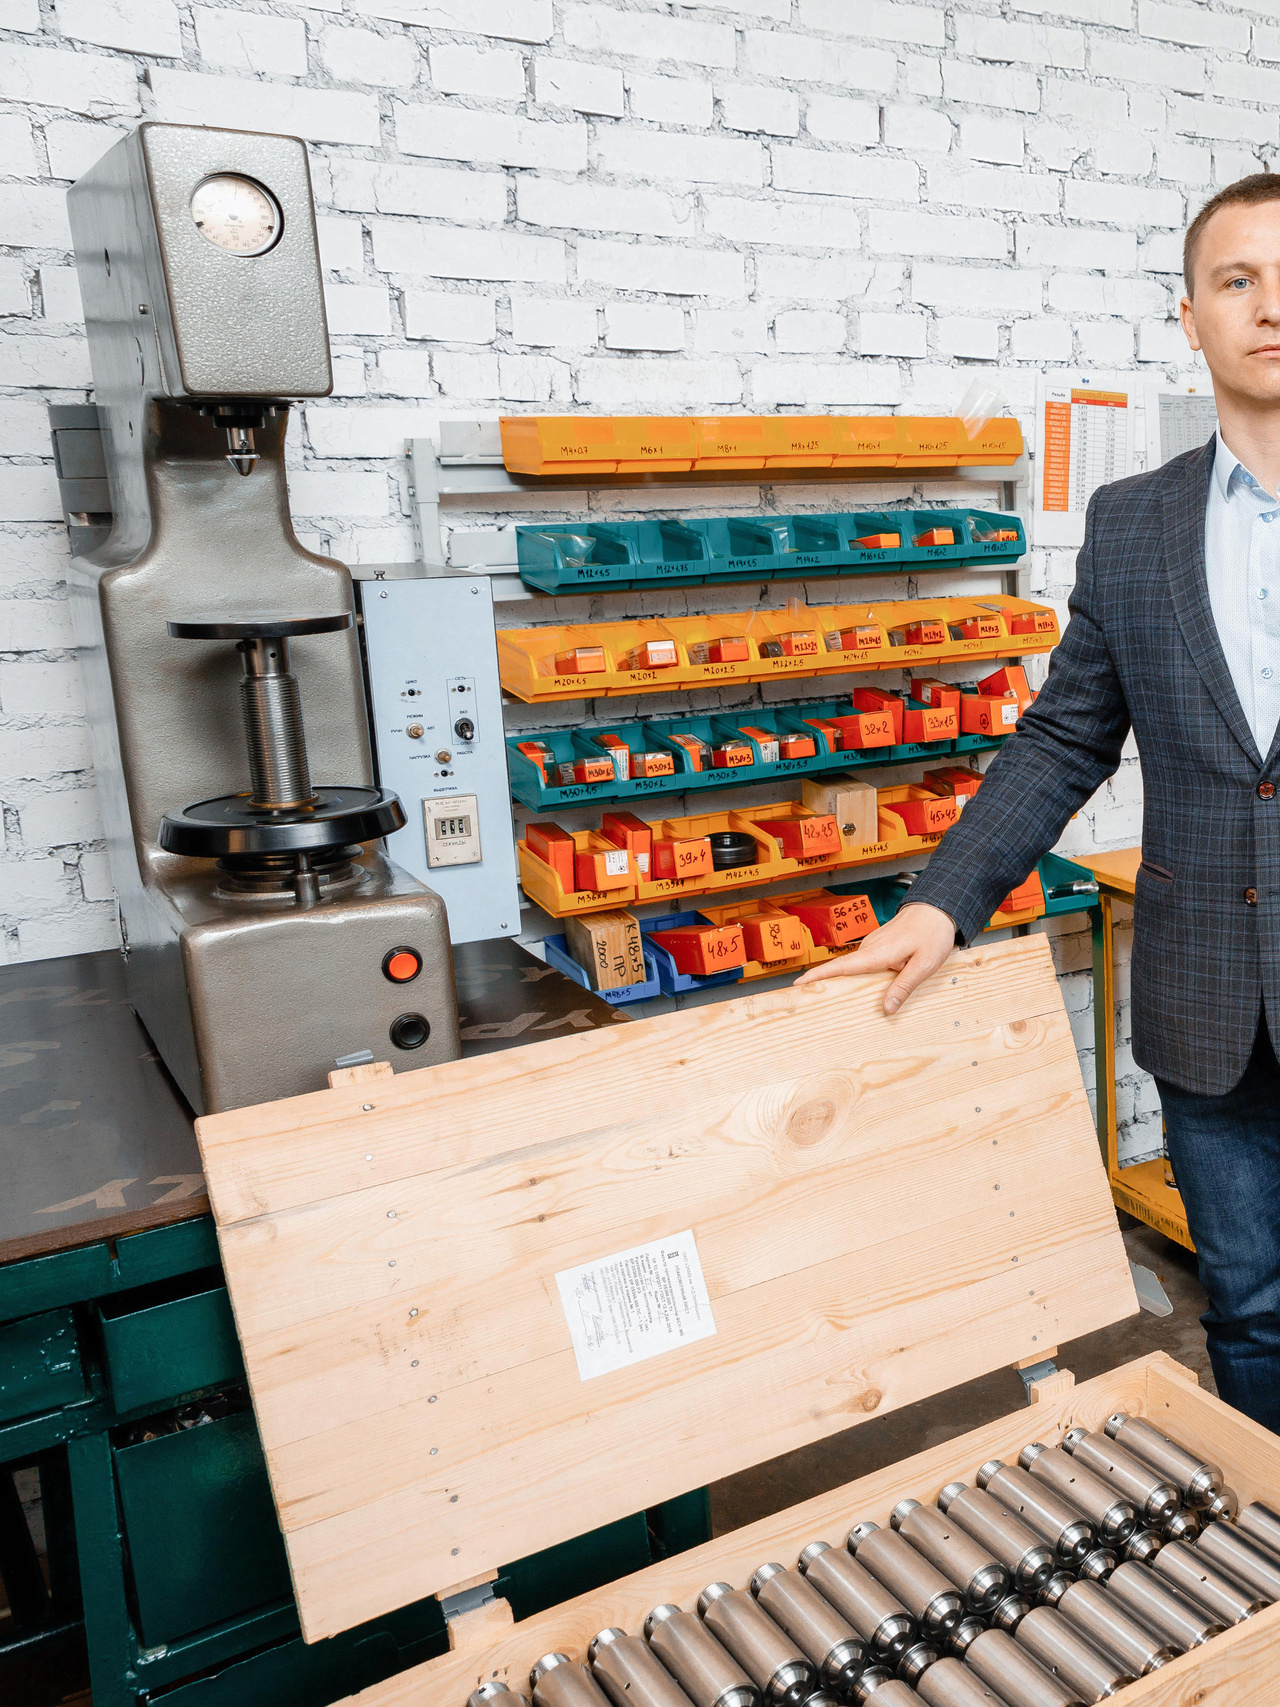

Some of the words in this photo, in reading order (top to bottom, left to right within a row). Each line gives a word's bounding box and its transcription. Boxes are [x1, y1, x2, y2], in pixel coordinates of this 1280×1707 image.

[864, 720, 890, 736] 32x2
[678, 849, 707, 868] 39x4
[596, 940, 609, 969] 2000
[707, 934, 740, 959] 48x5
